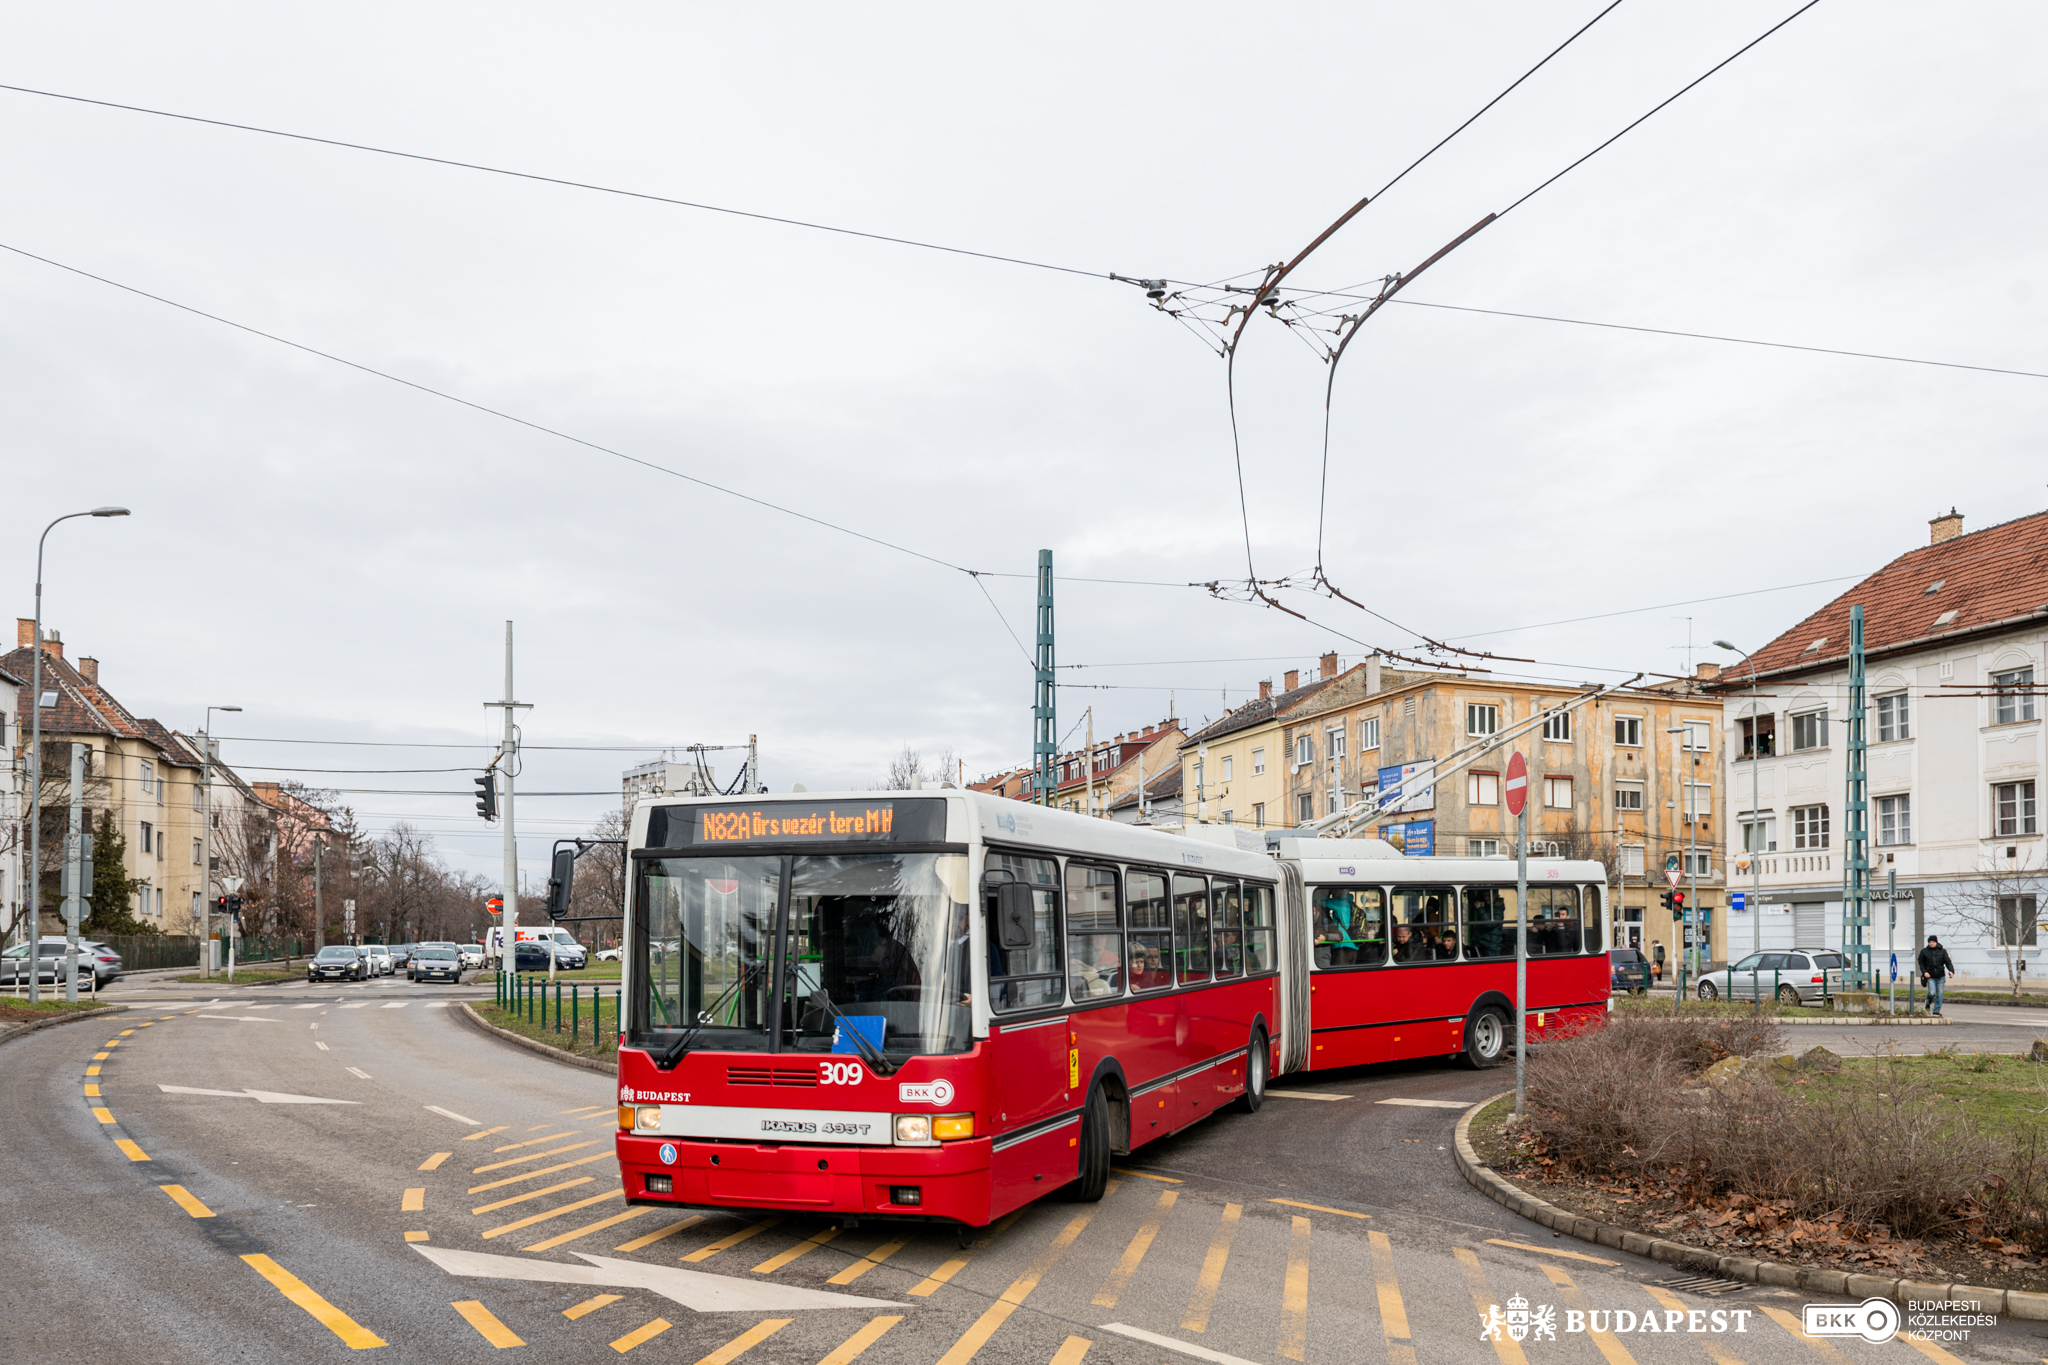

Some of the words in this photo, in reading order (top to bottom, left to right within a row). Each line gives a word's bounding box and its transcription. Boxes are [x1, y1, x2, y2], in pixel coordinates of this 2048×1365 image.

[703, 812, 750, 840] N82A
[752, 811, 779, 836] Örs
[782, 812, 826, 835] vezér
[829, 810, 865, 834] tere
[1546, 869, 1559, 878] 309
[1882, 889, 1914, 900] OTIKA
[819, 1062, 863, 1086] 309
[636, 1090, 691, 1103] BUDAPEST
[906, 1088, 929, 1098] BKK
[761, 1119, 817, 1134] IKARUS
